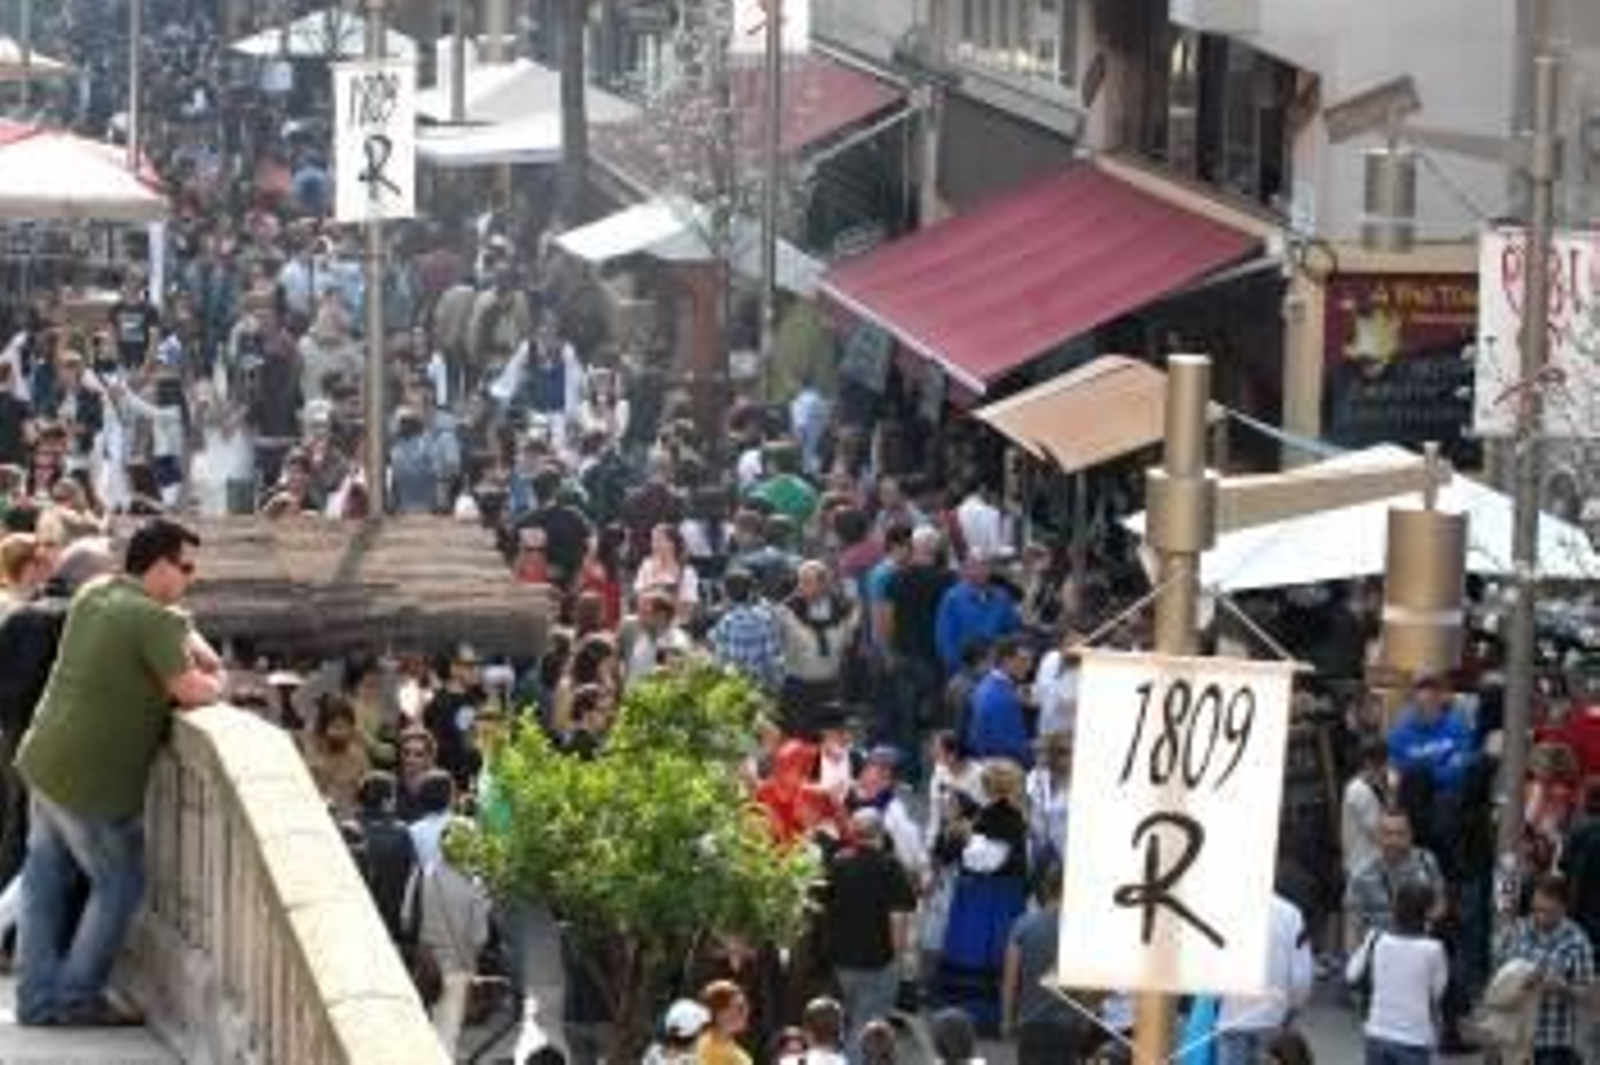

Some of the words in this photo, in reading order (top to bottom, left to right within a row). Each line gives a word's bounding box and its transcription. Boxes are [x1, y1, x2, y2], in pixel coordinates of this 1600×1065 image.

[358, 133, 402, 203] R
[1118, 679, 1256, 792] 1809
[1113, 811, 1226, 950] R
